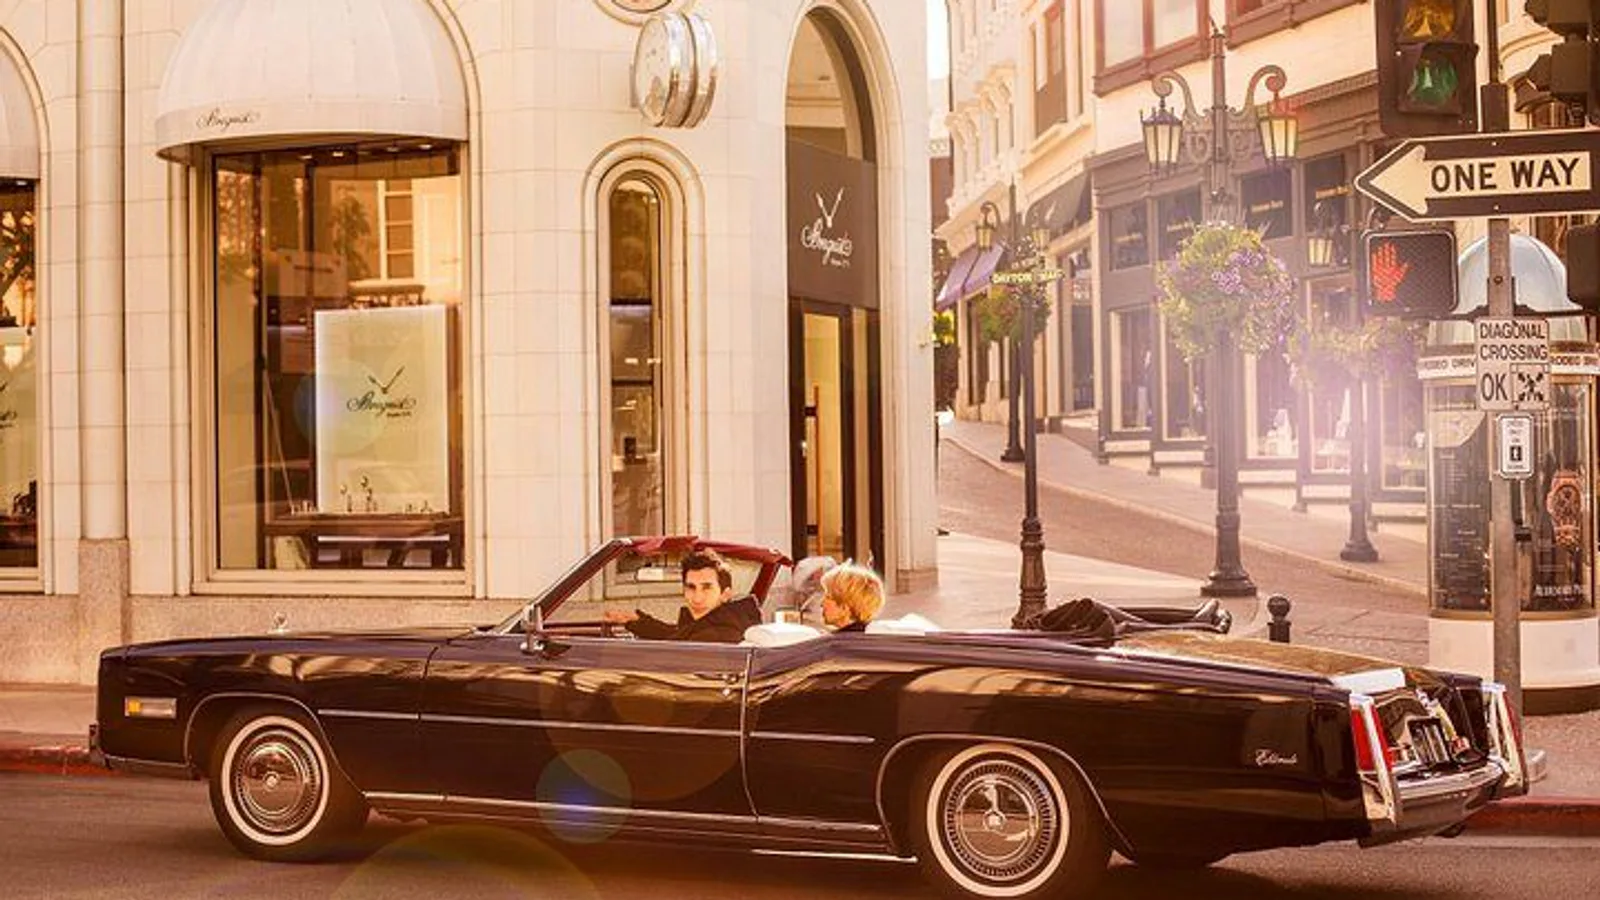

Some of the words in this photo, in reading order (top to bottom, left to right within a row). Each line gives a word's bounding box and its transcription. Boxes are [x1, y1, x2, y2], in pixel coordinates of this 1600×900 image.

[1431, 162, 1498, 193] ONE
[1510, 157, 1580, 189] WAY
[1479, 321, 1546, 339] DIAGONAL
[1479, 343, 1548, 361] CROSSING
[1451, 358, 1476, 369] DRIV
[1480, 372, 1508, 401] OK
